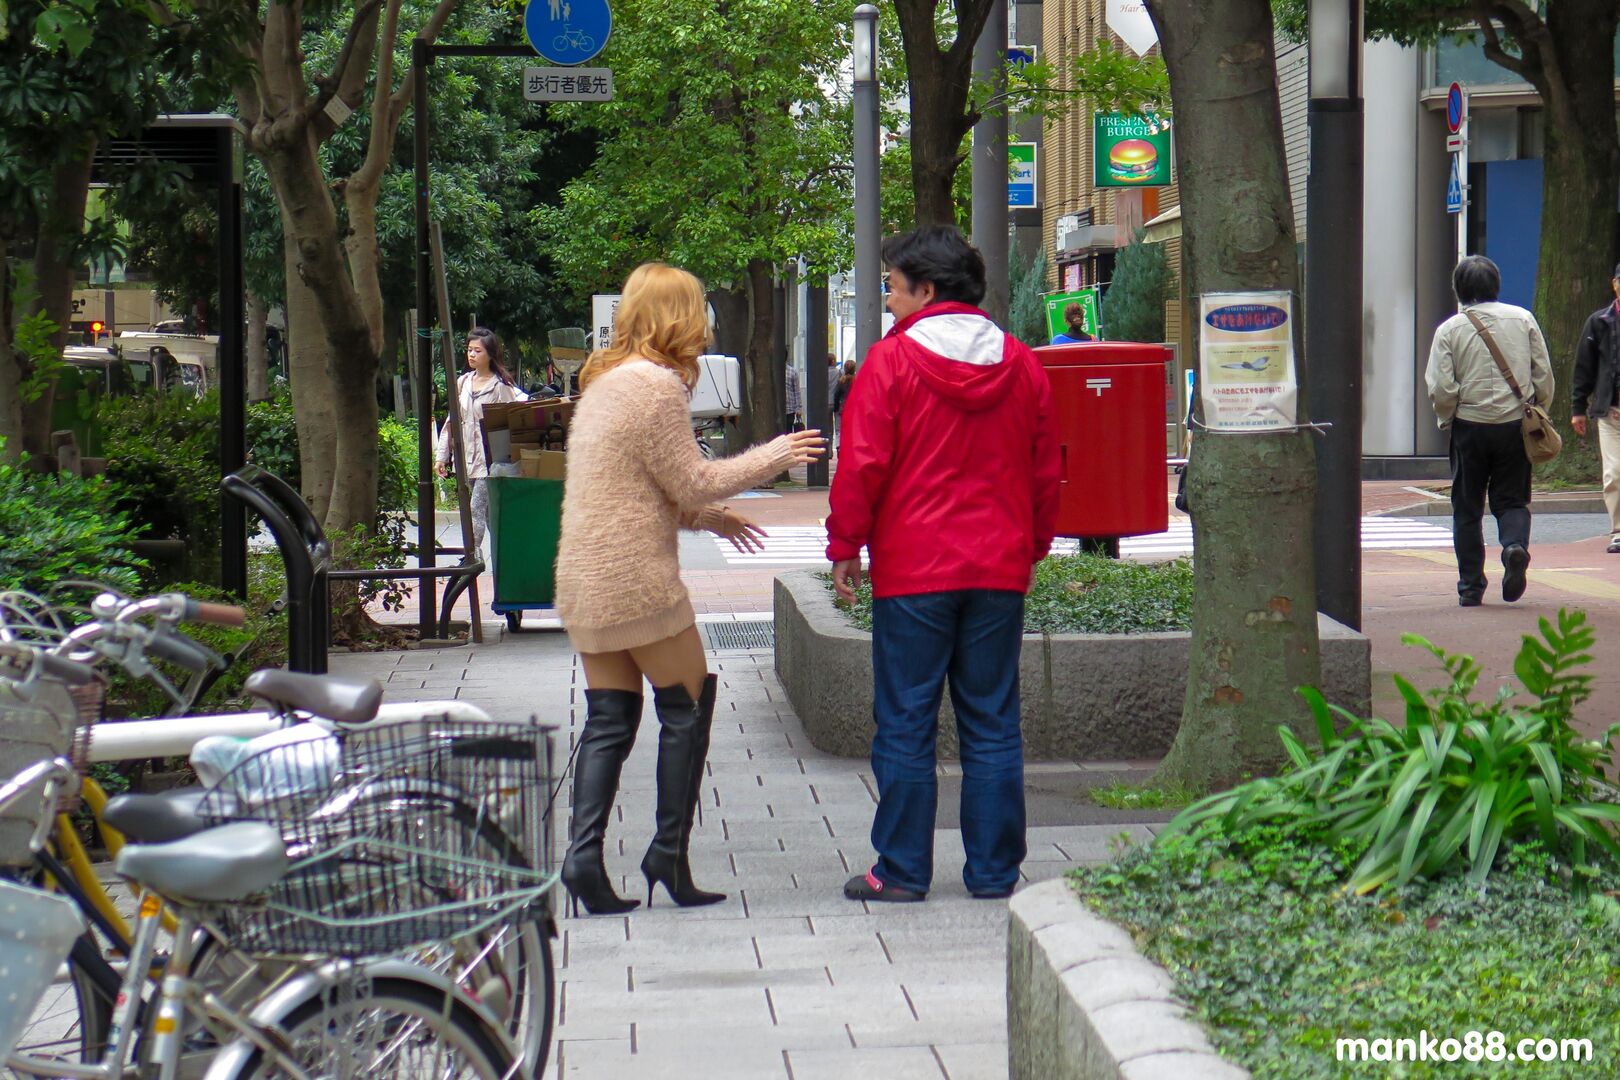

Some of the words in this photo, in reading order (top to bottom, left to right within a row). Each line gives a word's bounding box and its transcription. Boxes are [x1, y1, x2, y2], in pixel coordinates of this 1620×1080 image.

[528, 75, 608, 95] 歩行者優先
[1107, 126, 1156, 137] BURGE
